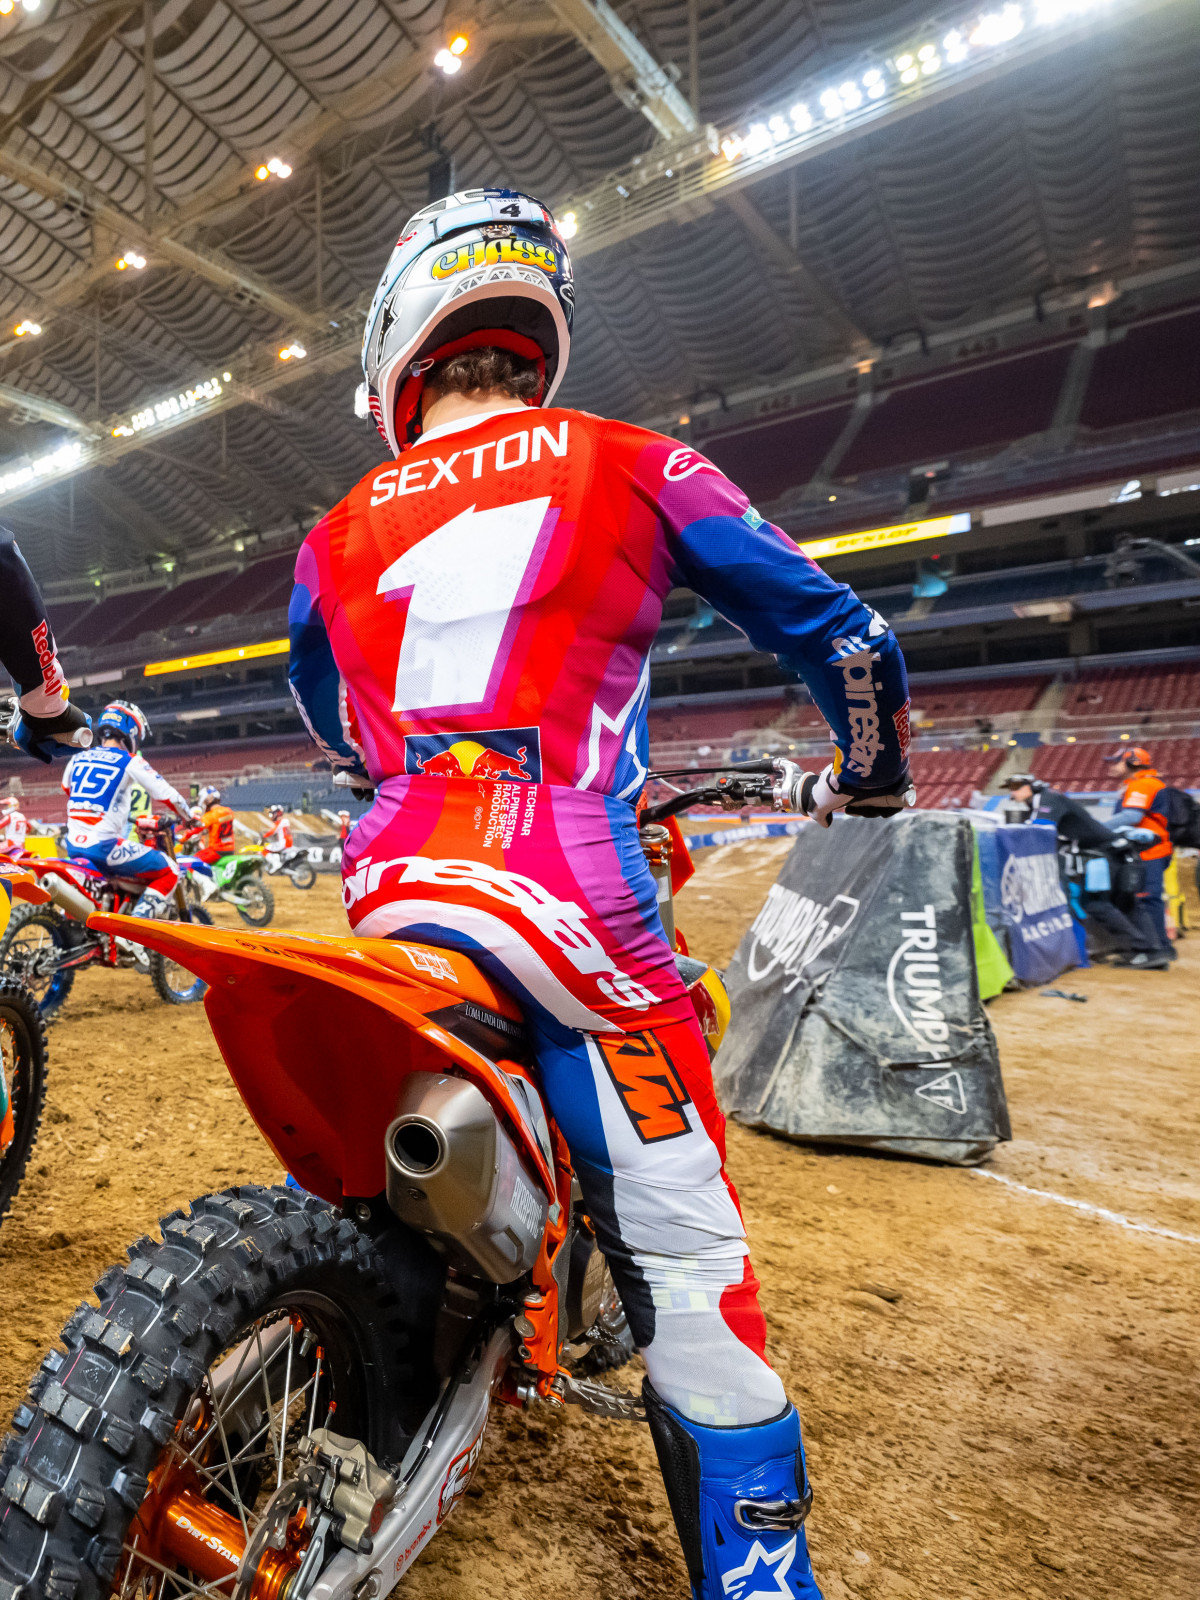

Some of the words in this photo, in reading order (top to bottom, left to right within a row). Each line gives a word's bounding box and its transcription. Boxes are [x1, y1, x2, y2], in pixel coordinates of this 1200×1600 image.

[499, 203, 522, 218] 4
[370, 420, 569, 507] SEXTON
[835, 526, 919, 550] DUNLOP
[376, 496, 553, 713] 1
[31, 619, 54, 669] Red
[70, 763, 120, 798] 45
[130, 789, 151, 812] 21
[500, 783, 512, 811] RACE
[482, 783, 503, 848] PRODUCTION
[494, 813, 508, 839] SPEC
[501, 783, 522, 850] ALPINESTARS
[520, 784, 538, 836] TECHSTAR
[888, 904, 953, 1069] TRIUMPH
[465, 1005, 481, 1021] LOMA
[481, 1011, 496, 1027] LINDA
[597, 1028, 693, 1143] KTM
[404, 1519, 432, 1562] brembo
